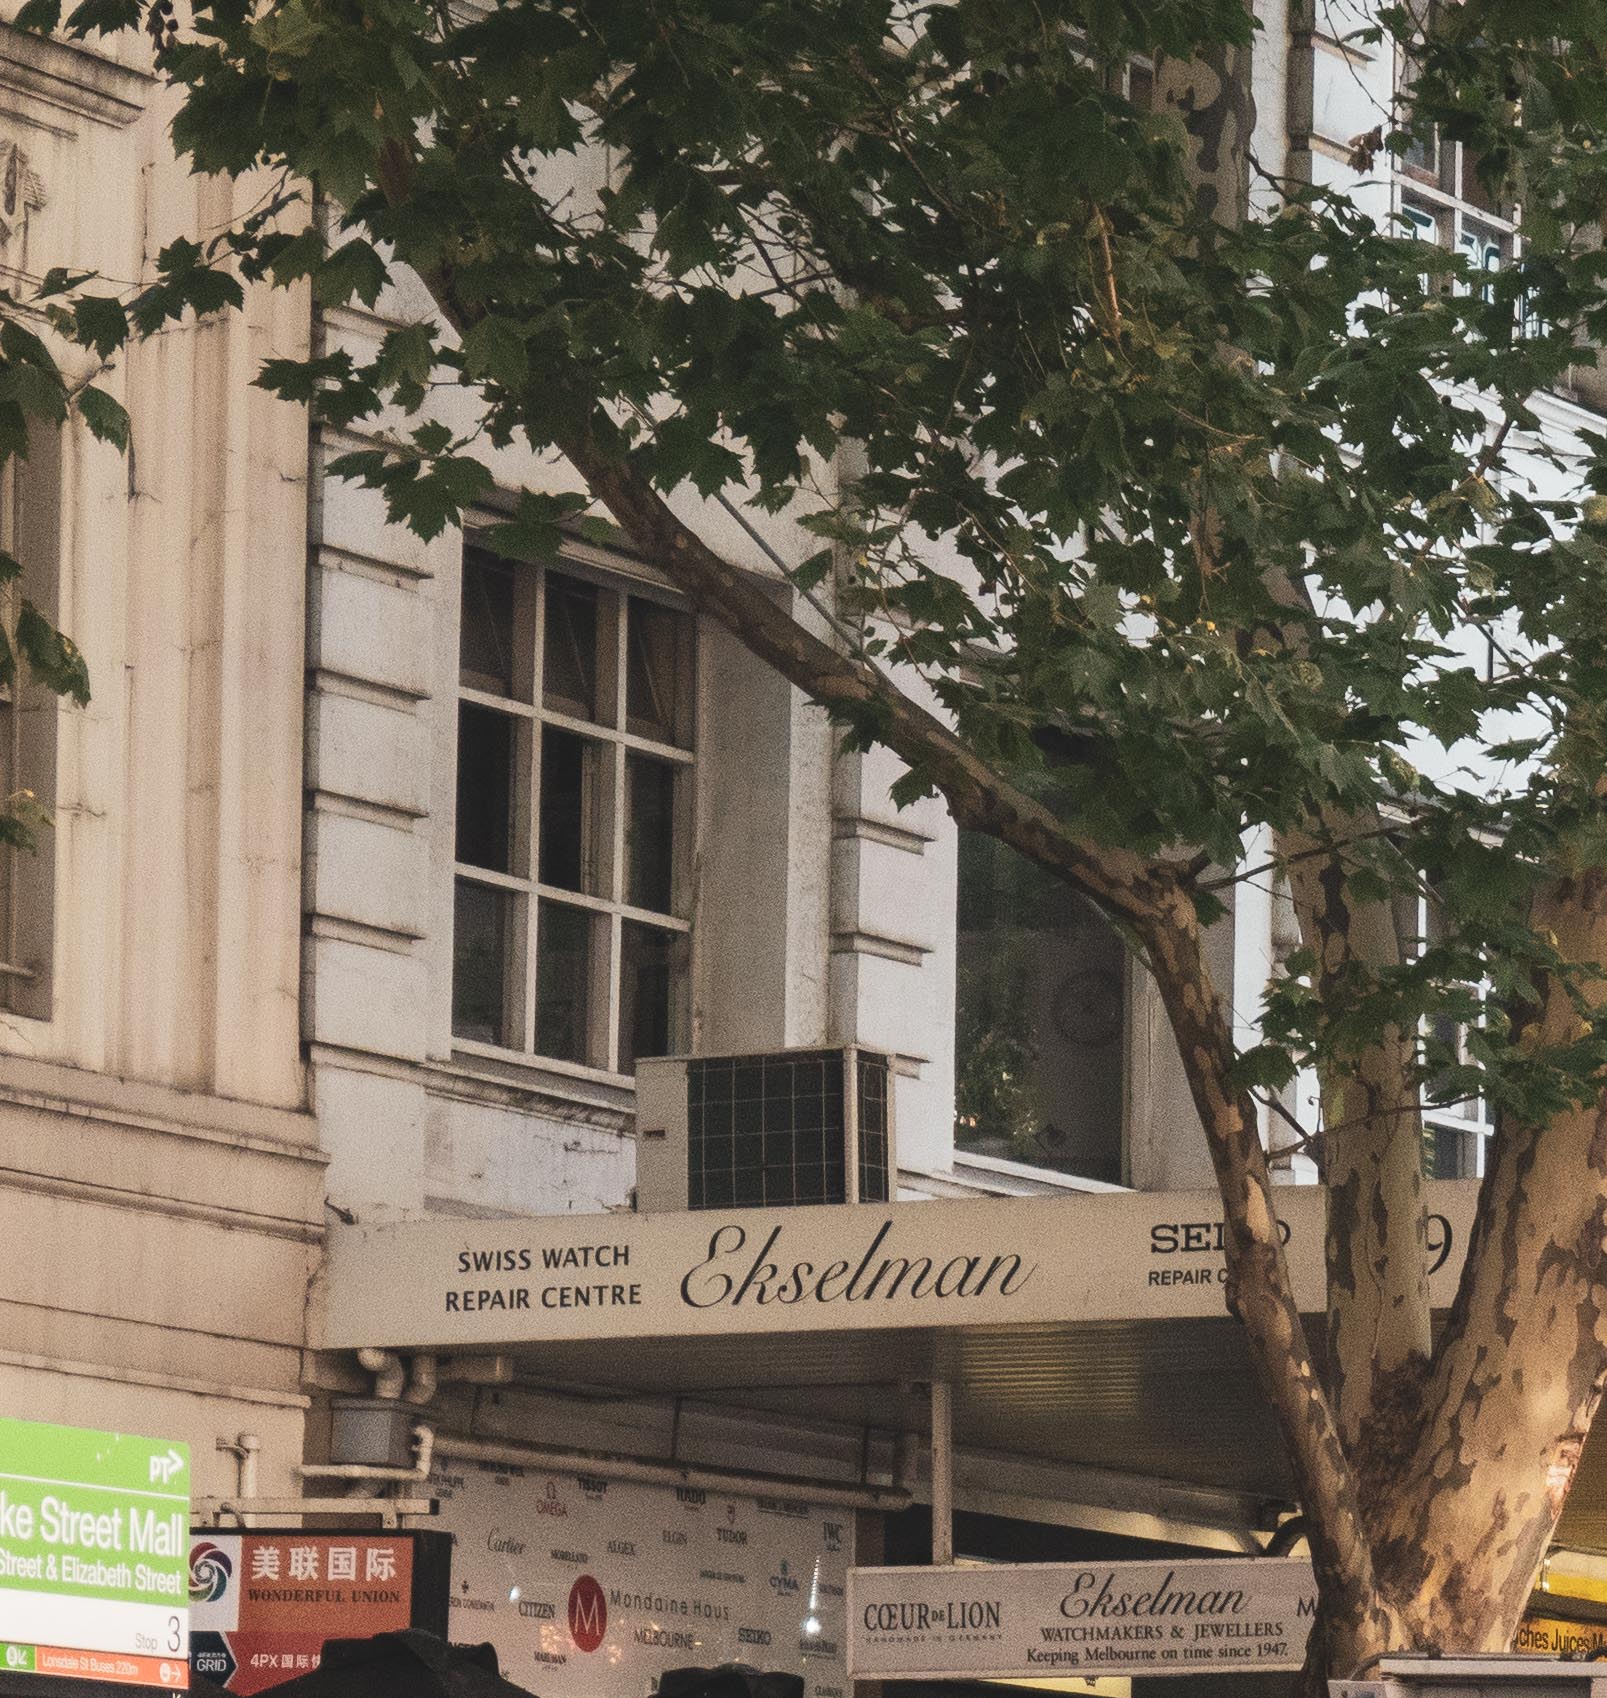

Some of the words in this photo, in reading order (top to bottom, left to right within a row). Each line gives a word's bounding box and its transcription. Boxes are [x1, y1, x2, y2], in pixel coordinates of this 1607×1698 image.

[458, 1248, 532, 1273] SWISS
[542, 1244, 631, 1270] WATCH
[680, 1219, 1039, 1309] Ekselman
[1148, 1268, 1212, 1287] REPAIR
[445, 1286, 531, 1313] REPAIR
[541, 1282, 643, 1309] CENTRE
[536, 1500, 568, 1518] OMEGA
[39, 1495, 123, 1551] Street
[129, 1507, 184, 1558] Mall
[716, 1527, 748, 1545] TUDOR
[251, 1544, 397, 1582] 美联国际
[46, 1554, 59, 1583] &
[61, 1555, 132, 1590] Elizabeth
[135, 1563, 182, 1595] Street
[769, 1576, 799, 1592] CYMA
[249, 1588, 345, 1604] WONDERFUL
[351, 1589, 400, 1604] UNION
[1058, 1571, 1246, 1620] Ekselman
[518, 1601, 556, 1619] CITIZEN
[947, 1601, 1001, 1629] LION
[135, 1632, 158, 1652] Stop
[167, 1615, 181, 1654] 3
[634, 1628, 695, 1650] MELBOURNE
[737, 1627, 772, 1646] SEIKO
[1040, 1625, 1164, 1643] WATCHMAKERS
[1171, 1625, 1185, 1639] &
[1193, 1622, 1284, 1639] JEWELLERS
[1551, 1628, 1592, 1653] Juices
[196, 1658, 227, 1672] GRID
[250, 1654, 279, 1669] 4PX
[1026, 1646, 1078, 1667] Keeping
[1085, 1644, 1157, 1663] Melbourne
[1161, 1648, 1178, 1660] on
[1183, 1645, 1214, 1660] time
[1218, 1643, 1252, 1659] since
[79, 1656, 89, 1671] St
[89, 1658, 115, 1674] Buses
[115, 1660, 139, 1677] 220m
